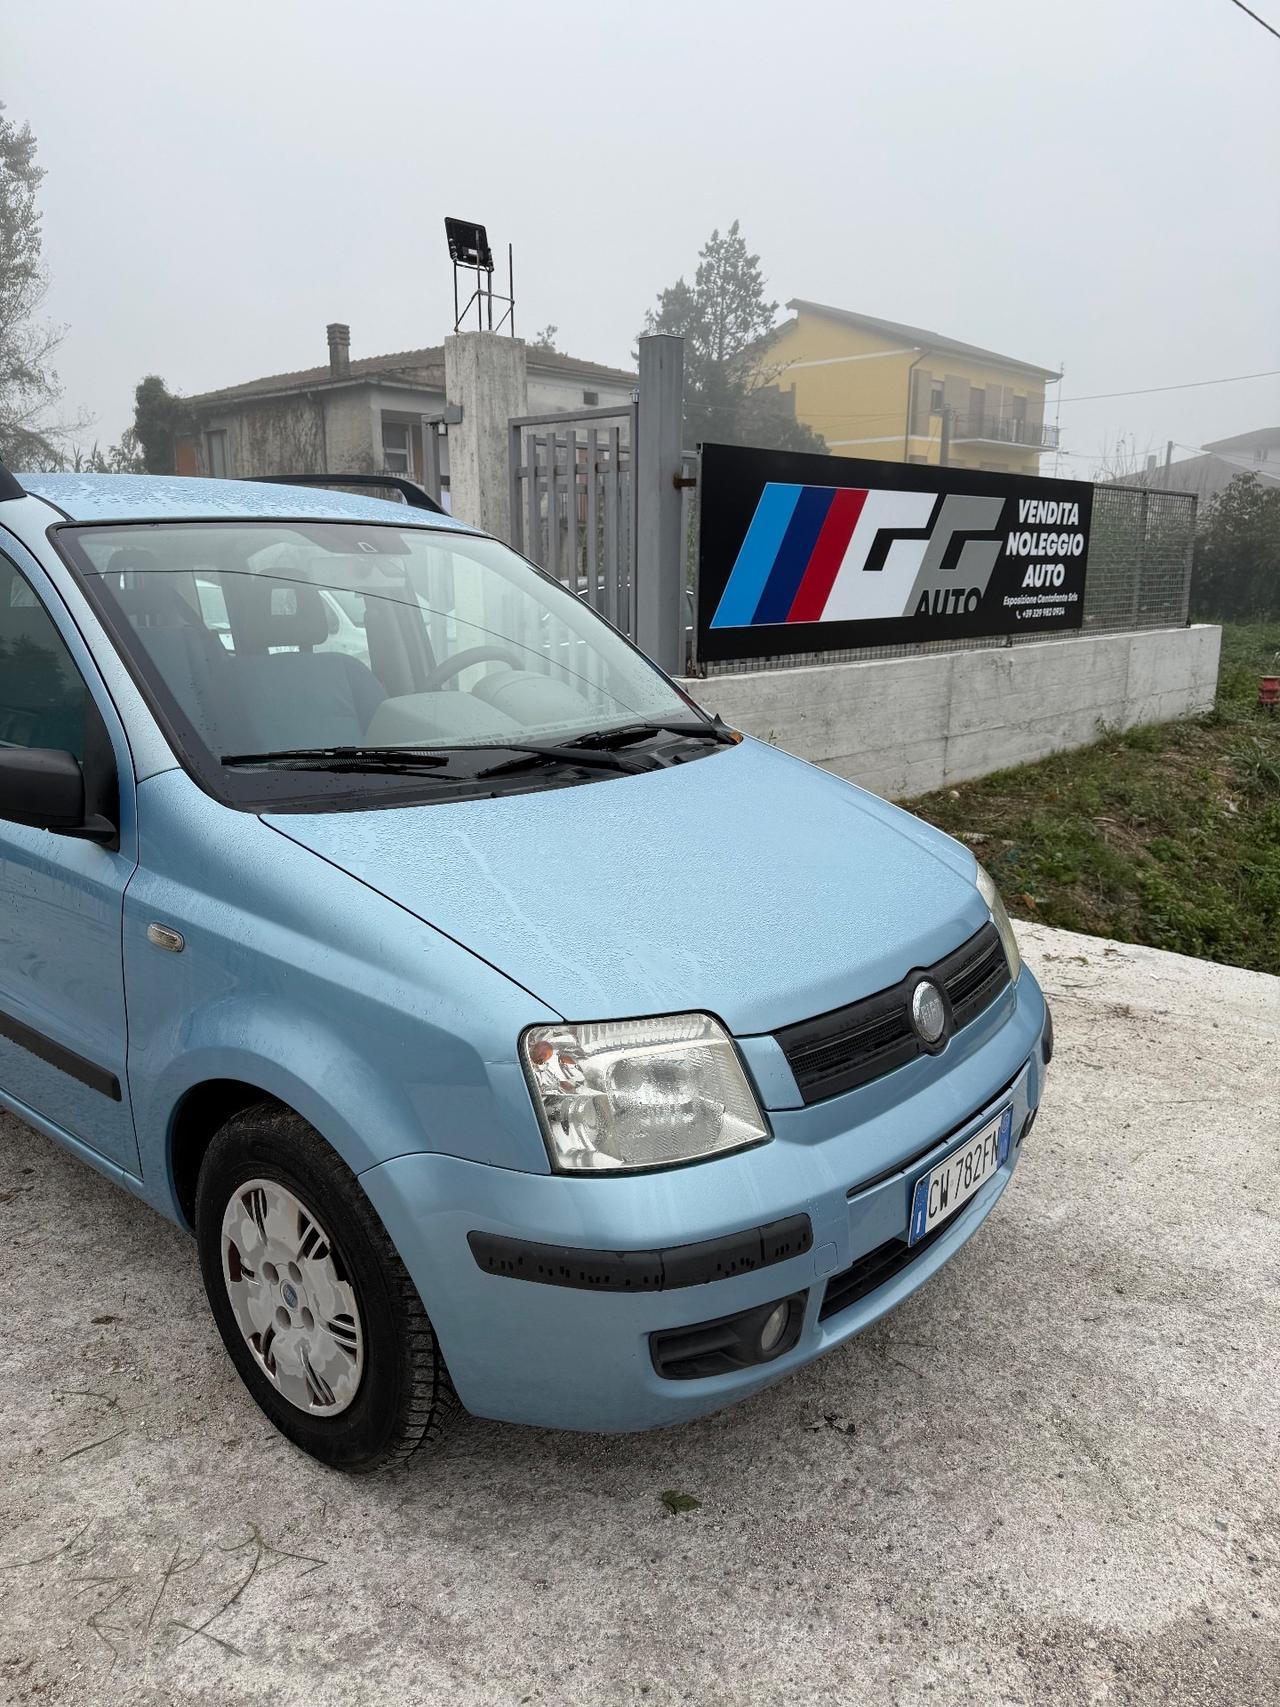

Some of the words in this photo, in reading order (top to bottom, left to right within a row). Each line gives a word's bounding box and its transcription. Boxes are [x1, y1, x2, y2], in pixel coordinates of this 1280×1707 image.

[1019, 498, 1079, 525] VENDITA
[1005, 531, 1084, 556] NOLEGGIO
[1021, 563, 1066, 588] AUTO
[915, 587, 982, 615] AUTO
[1003, 594, 1036, 607] Esposizione
[928, 1169, 950, 1219] CW
[954, 1126, 1000, 1200] 782FN
